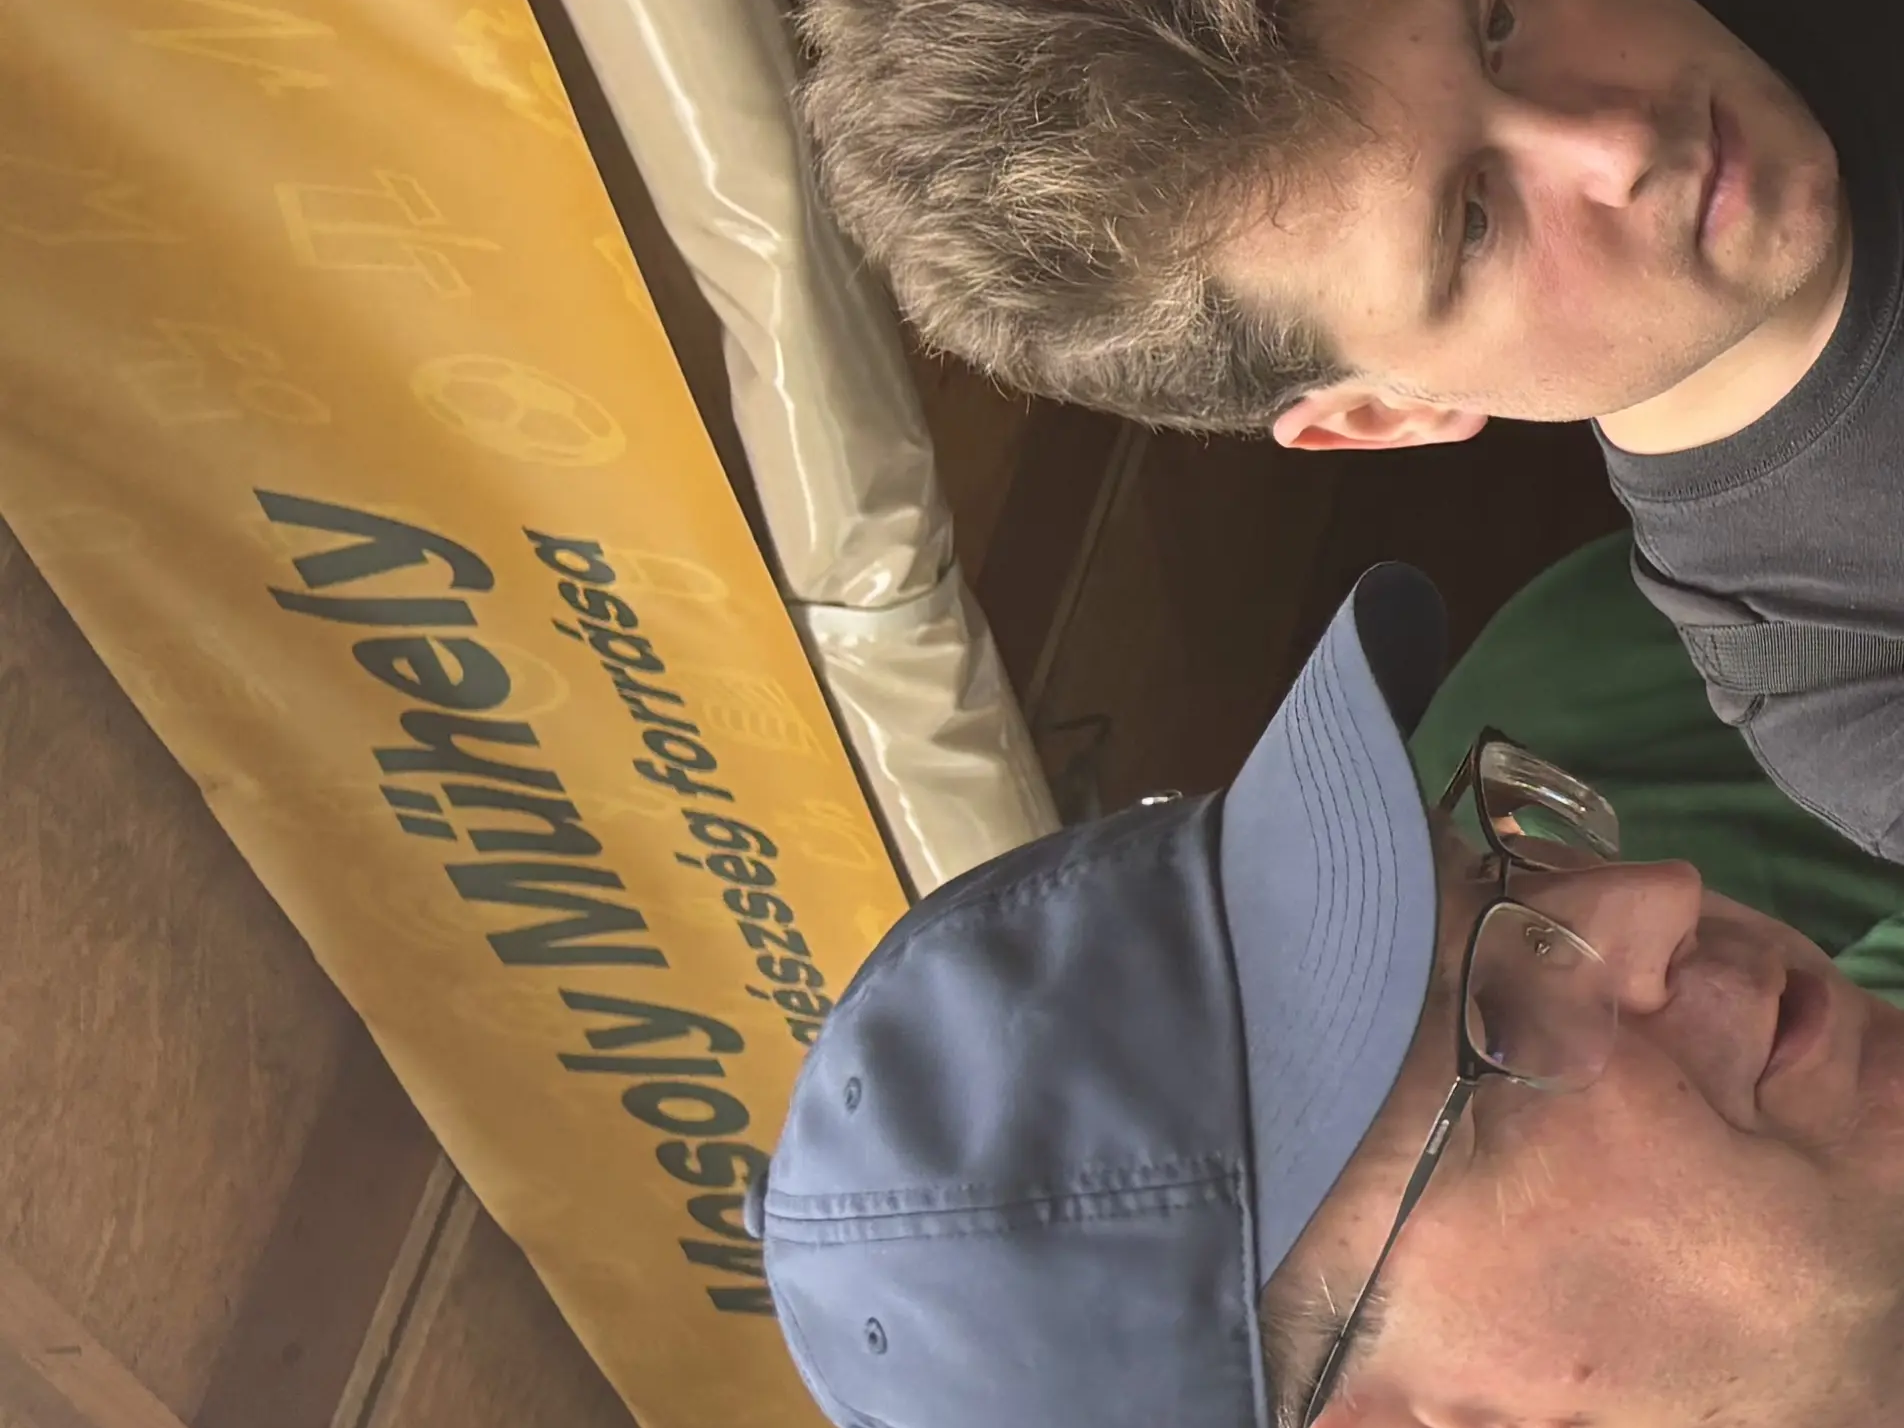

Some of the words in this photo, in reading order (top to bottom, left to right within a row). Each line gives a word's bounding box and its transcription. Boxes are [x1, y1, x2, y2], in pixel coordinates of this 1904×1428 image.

[253, 488, 668, 967] Műhely
[522, 525, 735, 803] forrása
[676, 809, 838, 1050] gészség
[557, 988, 771, 1317] Mosoly
